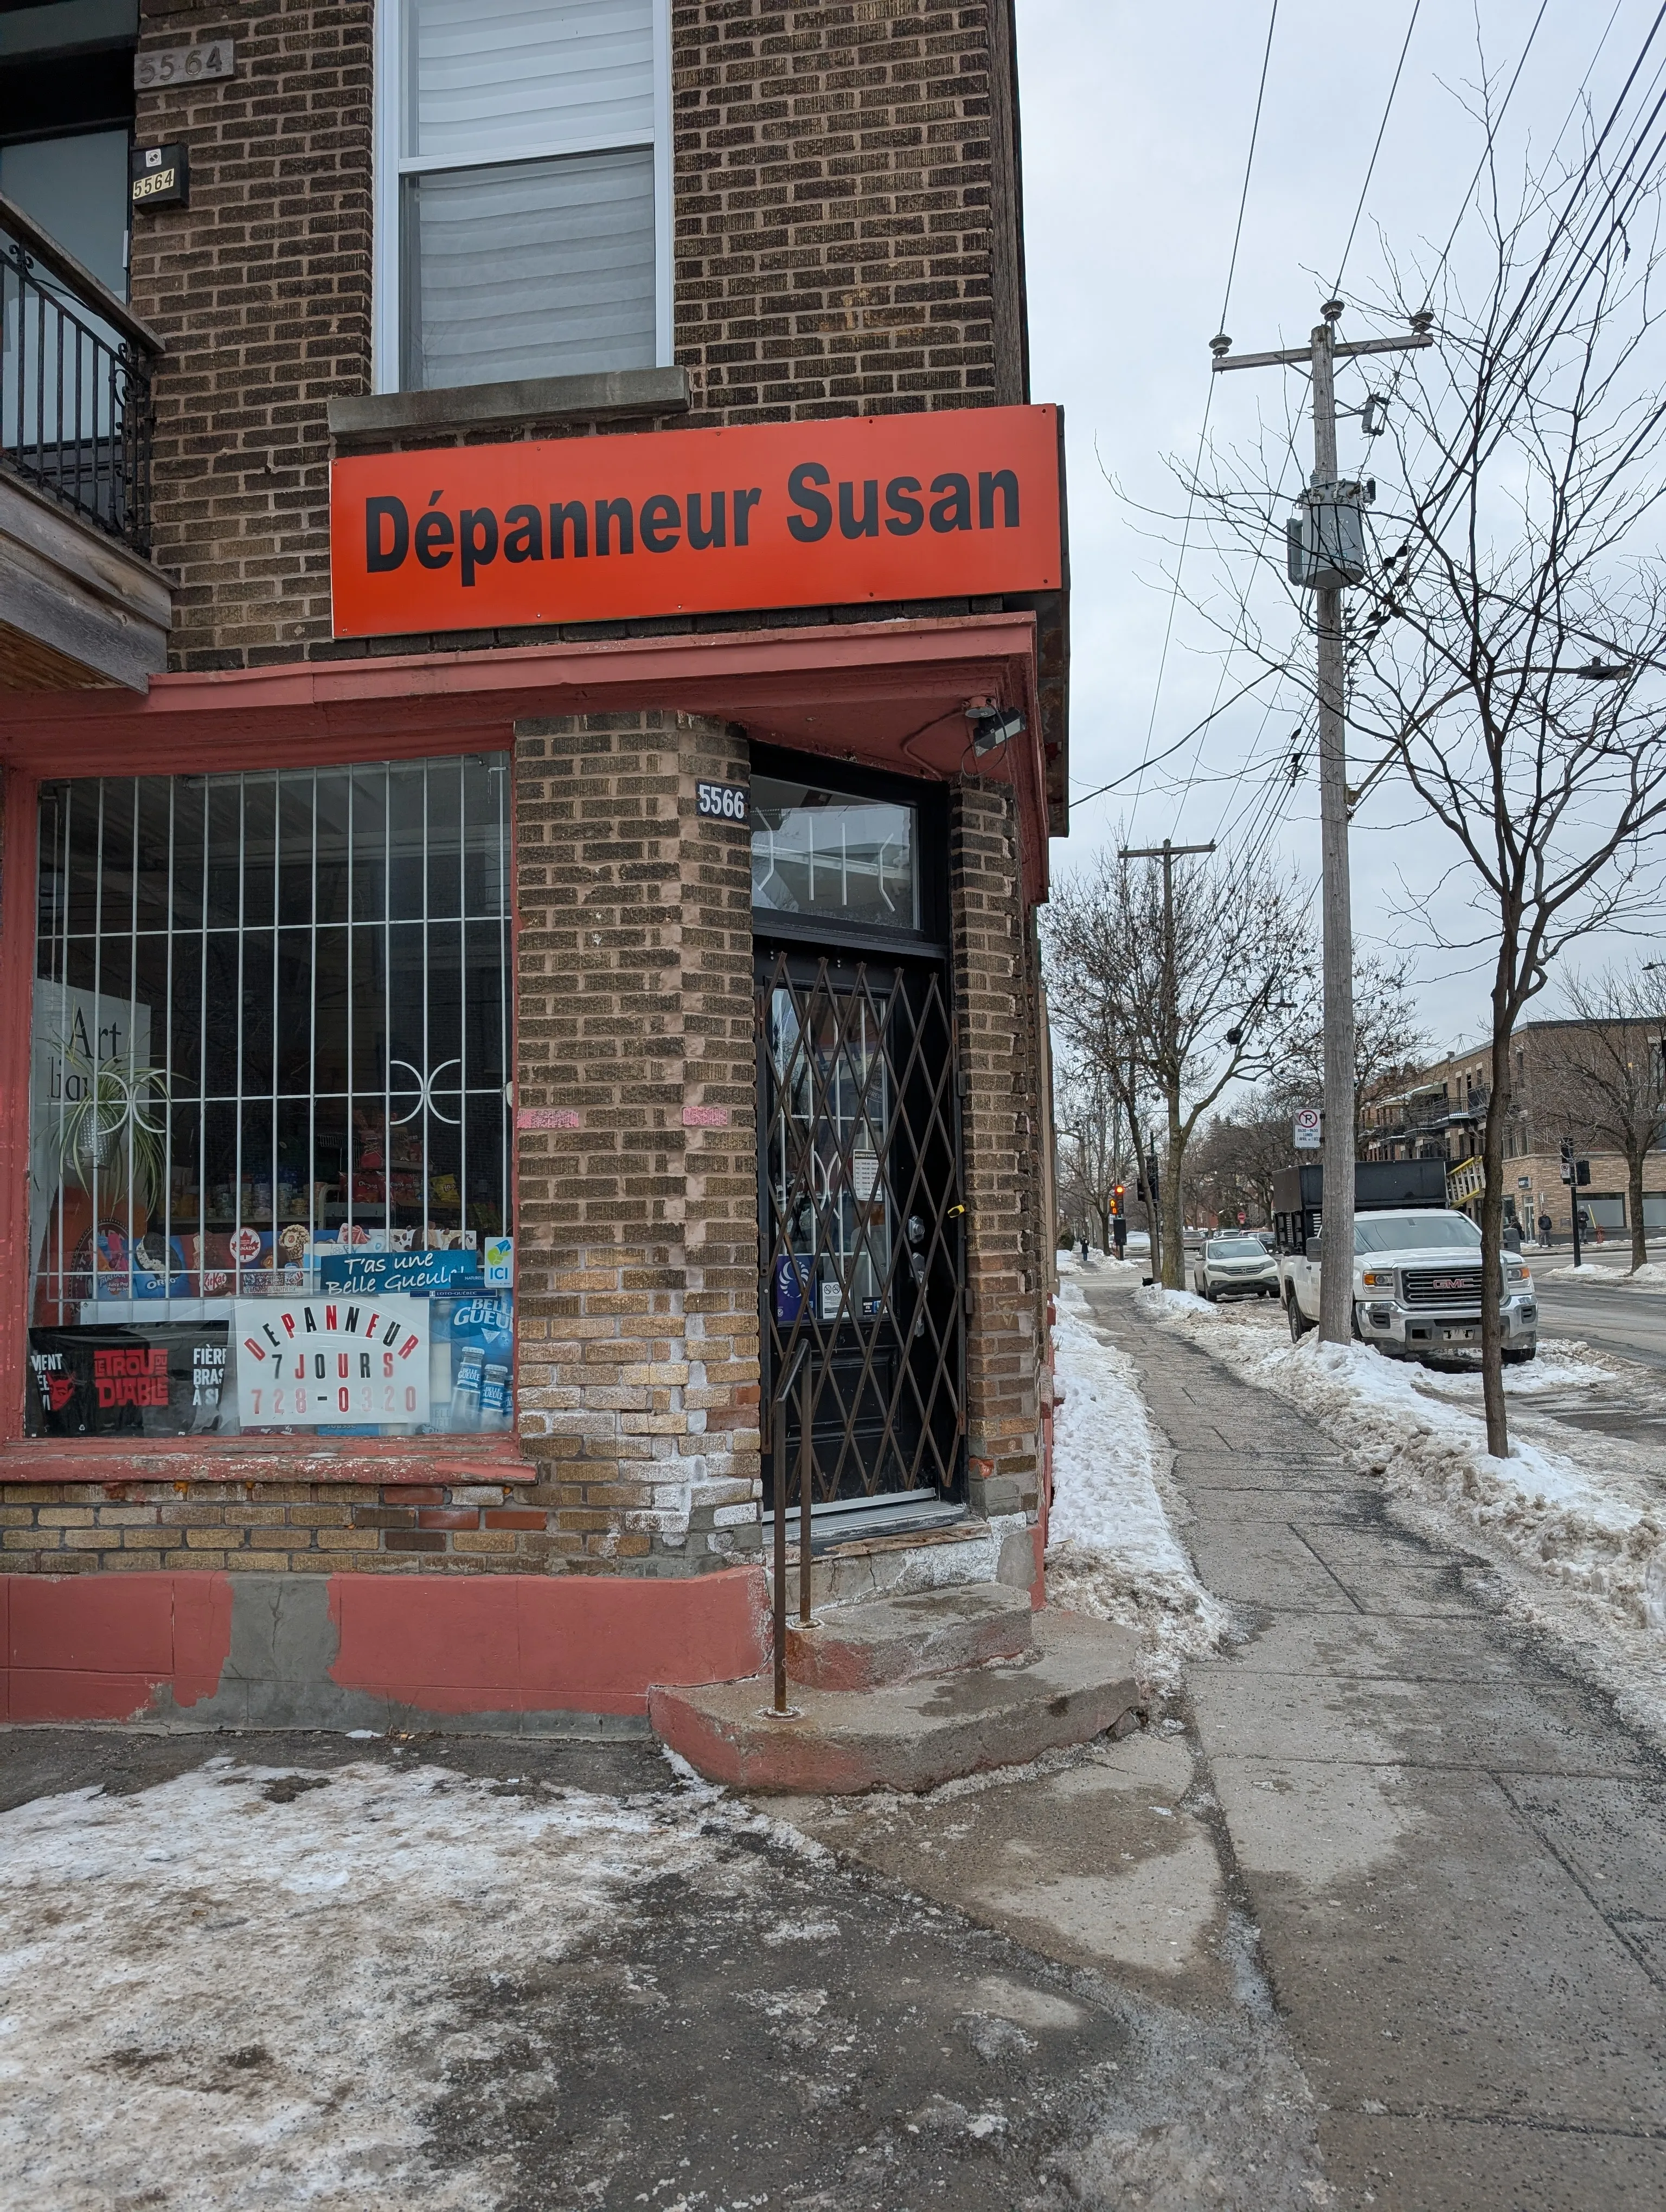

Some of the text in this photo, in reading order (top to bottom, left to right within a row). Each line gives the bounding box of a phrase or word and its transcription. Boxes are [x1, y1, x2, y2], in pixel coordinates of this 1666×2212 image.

[139, 46, 222, 84] 5564
[134, 170, 174, 198] 5564
[365, 461, 1020, 587] Dépanneur Susan
[699, 784, 745, 819] 5566
[68, 1007, 123, 1064] Art
[344, 1252, 434, 1275] T'as une
[490, 1267, 508, 1279] ICI
[146, 1277, 176, 1290] ORO
[325, 1275, 376, 1295] Belle
[1433, 1278, 1474, 1289] GMC
[244, 1304, 419, 1361] DEPANNEUR
[94, 1349, 168, 1377] TROU
[271, 1352, 394, 1379] 7 JOURS
[458, 1371, 480, 1381] GUEULE
[95, 1375, 169, 1408] DIABLE
